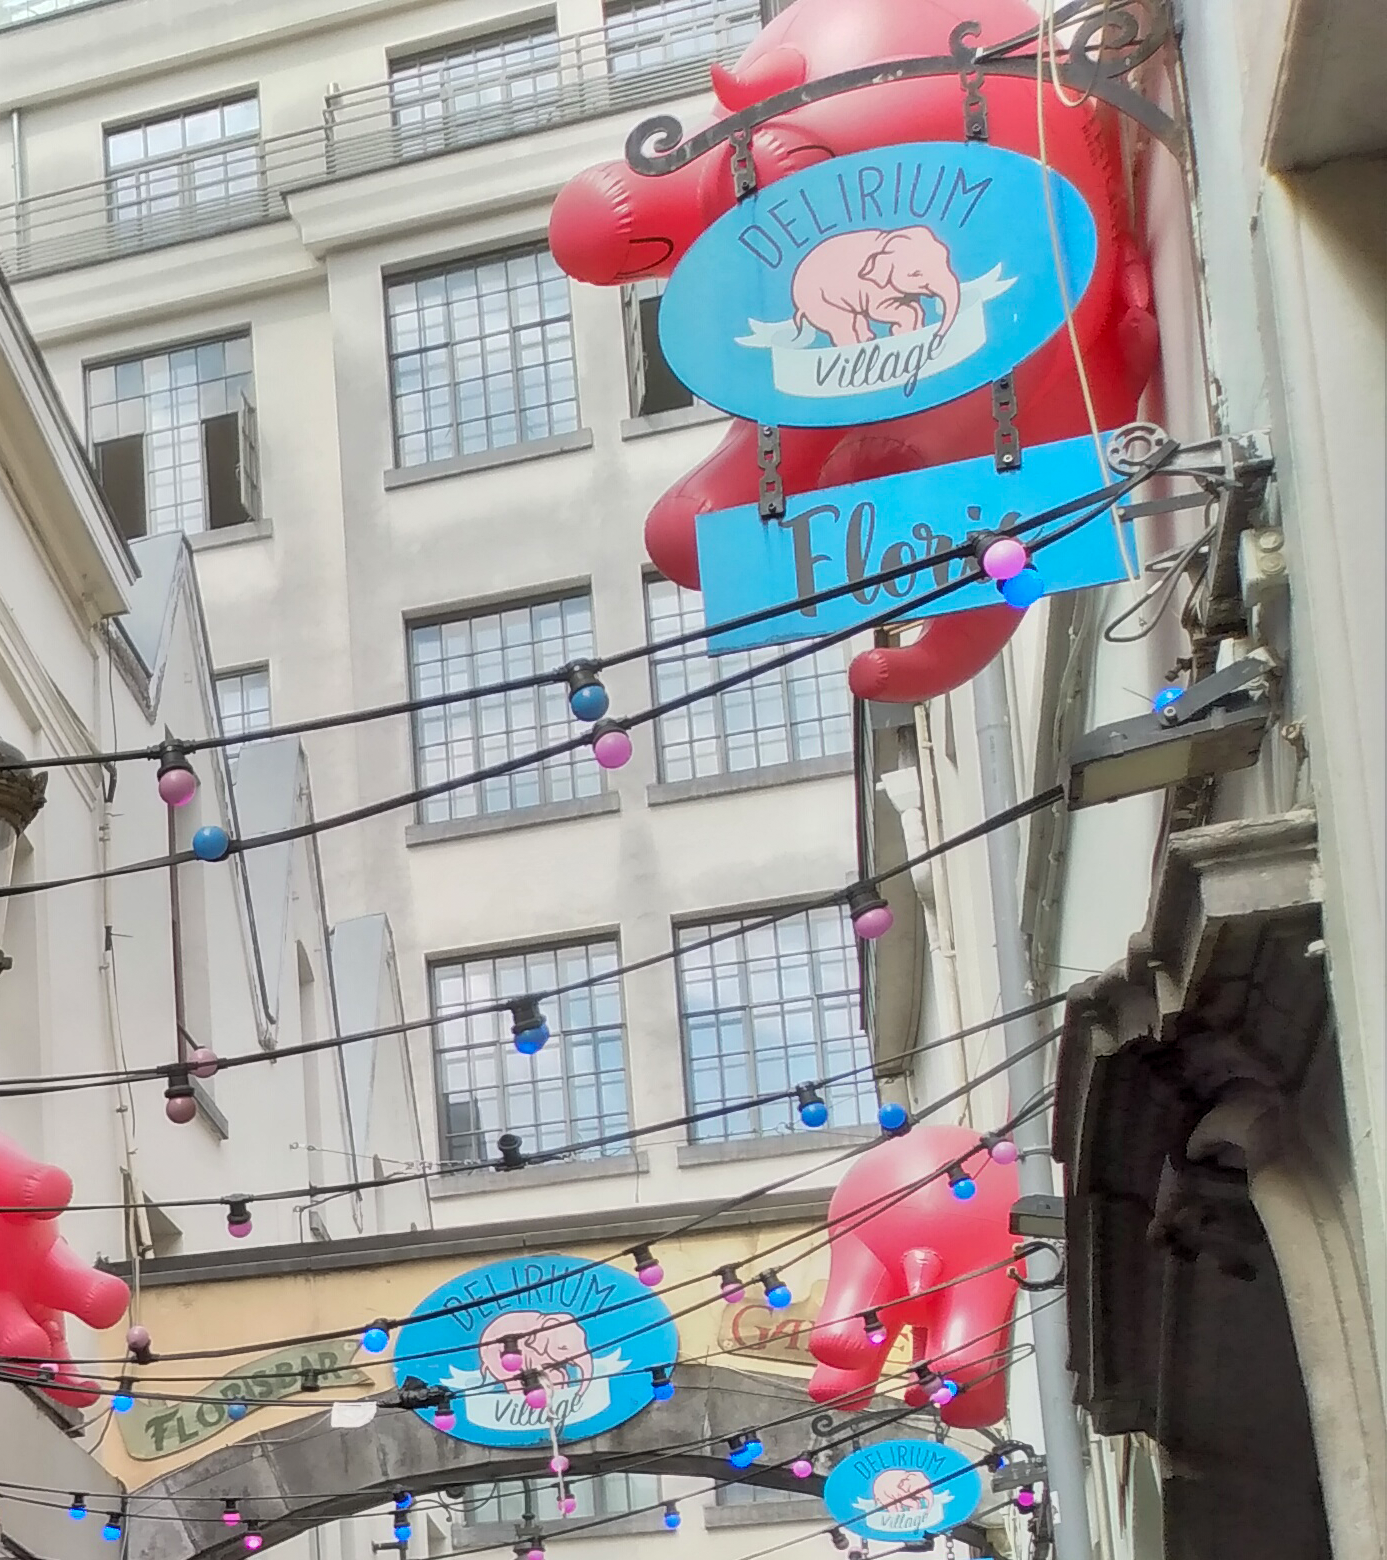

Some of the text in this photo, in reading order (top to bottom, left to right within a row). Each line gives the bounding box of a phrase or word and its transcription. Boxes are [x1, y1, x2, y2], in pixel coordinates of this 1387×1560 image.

[736, 160, 994, 270] DELIRIUM
[814, 330, 948, 398] Village
[778, 500, 1045, 618] Flori
[443, 1264, 617, 1332] DELIRIUM
[145, 1351, 342, 1451] FLORISBAR
[853, 1445, 947, 1481] DELIRIUM
